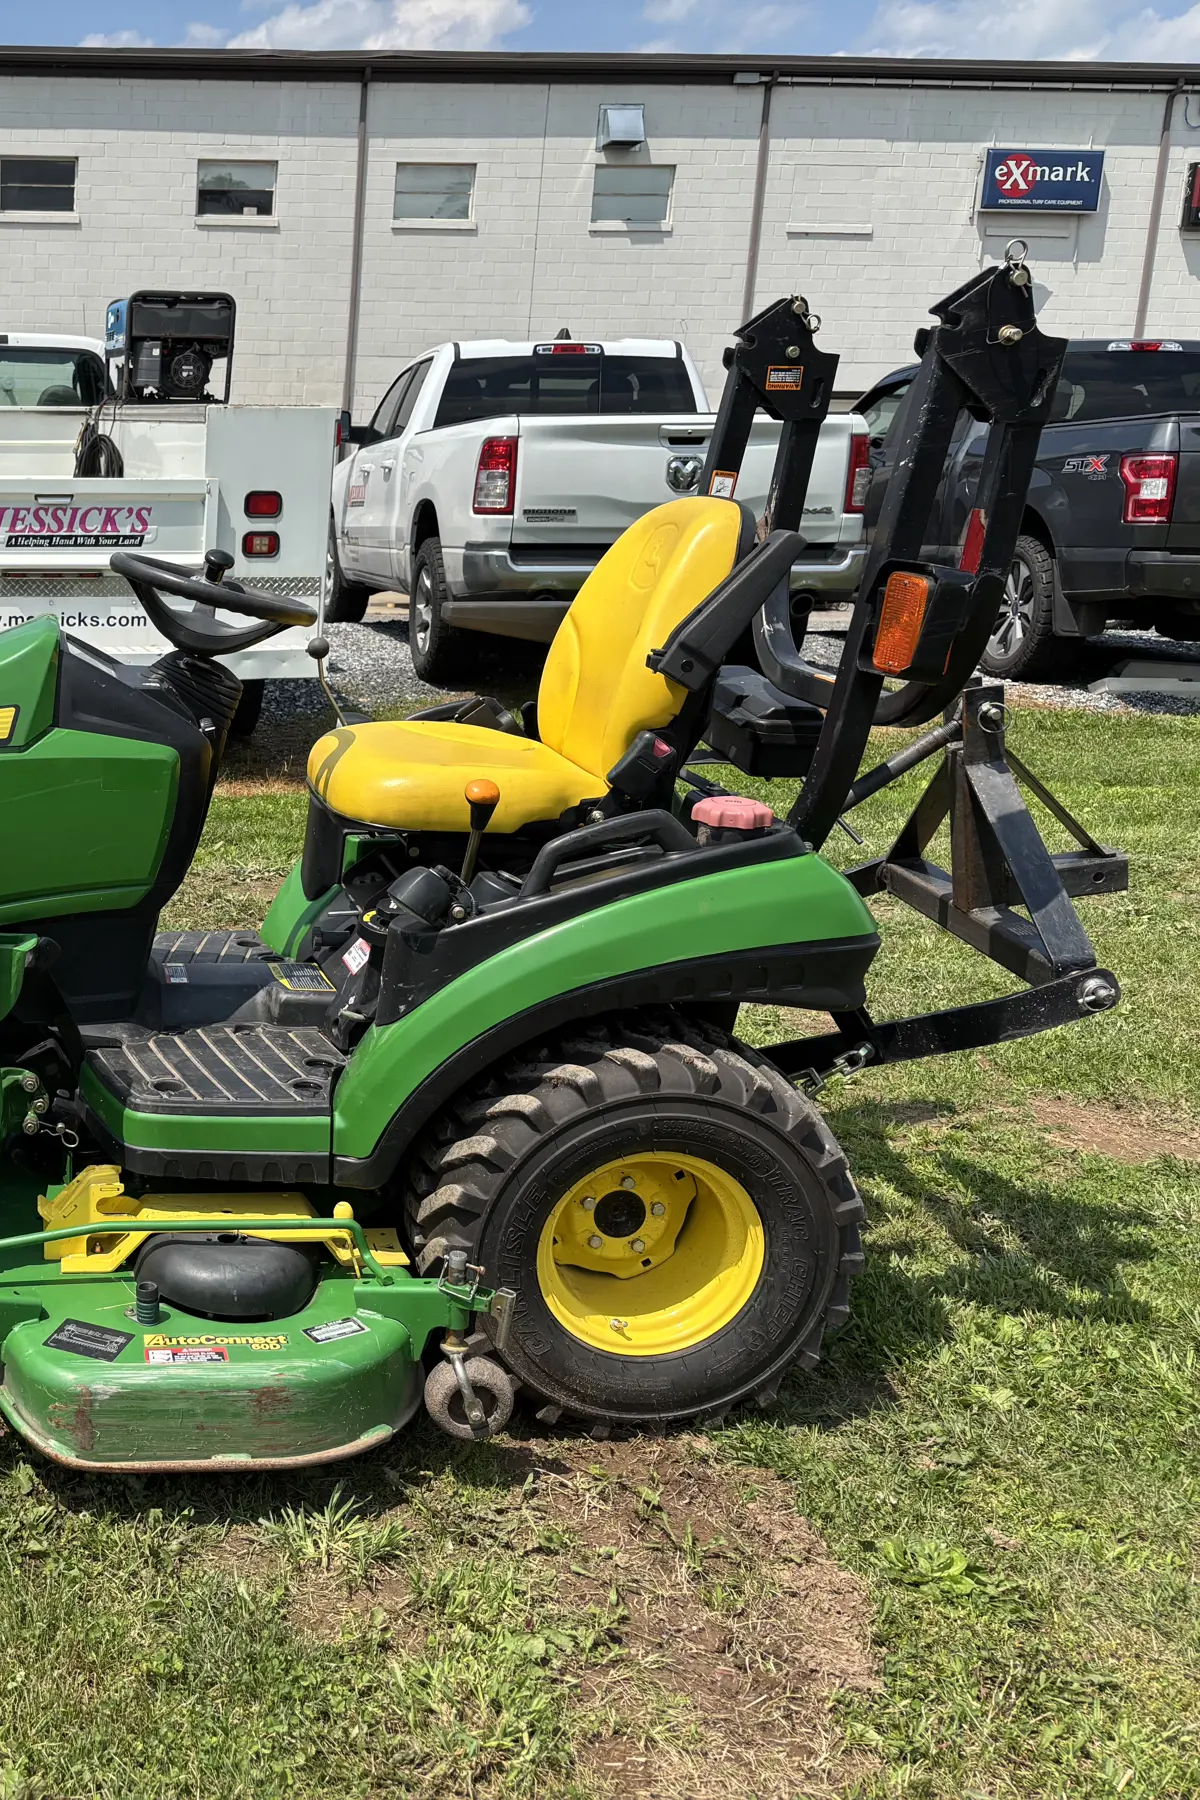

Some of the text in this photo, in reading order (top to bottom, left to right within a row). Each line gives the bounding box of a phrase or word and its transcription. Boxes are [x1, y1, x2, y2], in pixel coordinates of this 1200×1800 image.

[995, 160, 1092, 190] eXmark
[1061, 455, 1111, 475] STX
[8, 536, 141, 547] A Helping Hand With Your Land
[146, 1334, 290, 1346] AutoConnect
